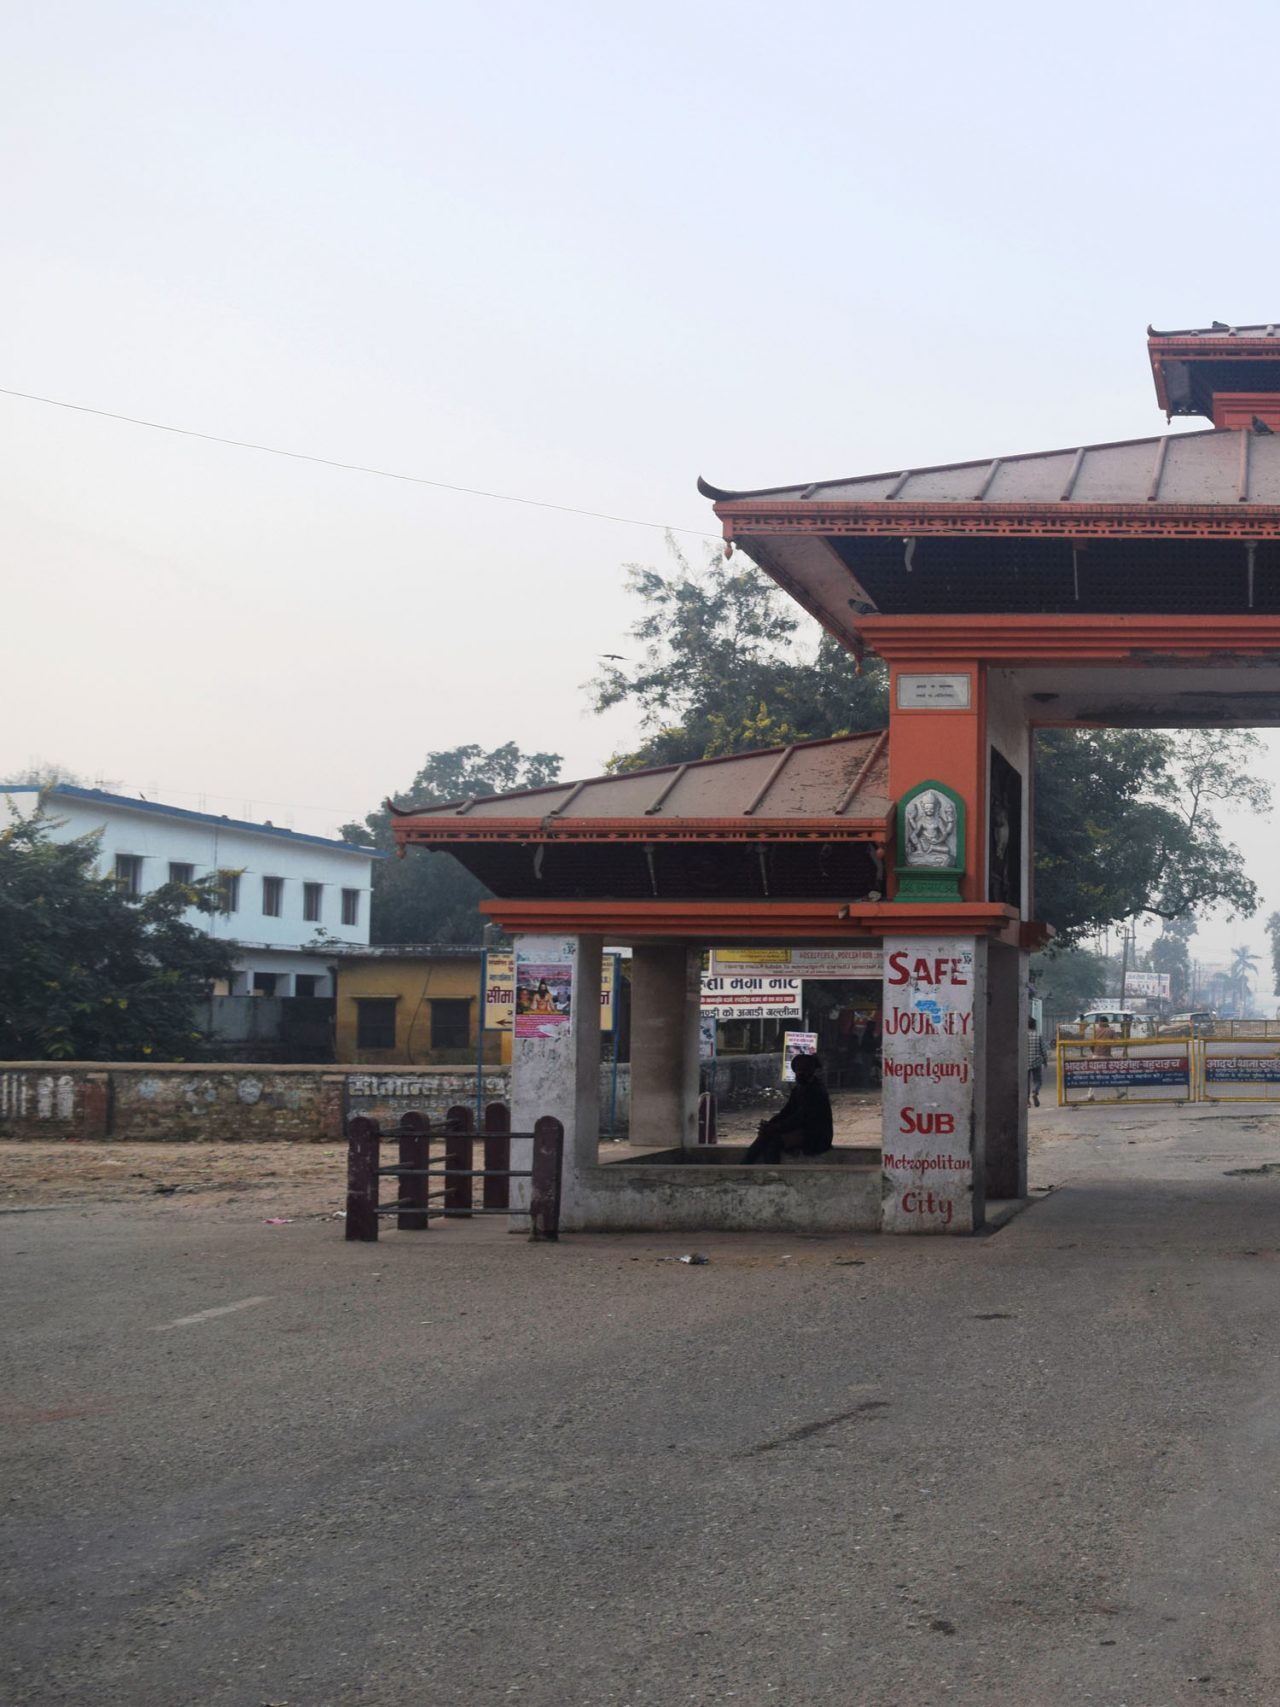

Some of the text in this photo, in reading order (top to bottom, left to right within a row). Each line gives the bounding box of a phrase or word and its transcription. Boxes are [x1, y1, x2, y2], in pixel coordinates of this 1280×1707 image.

[888, 951, 967, 985] SAFE
[884, 1057, 968, 1084] Nepalgunj
[900, 1106, 955, 1134] SUB
[884, 1154, 970, 1175] Metropolitan
[902, 1192, 952, 1224] City
